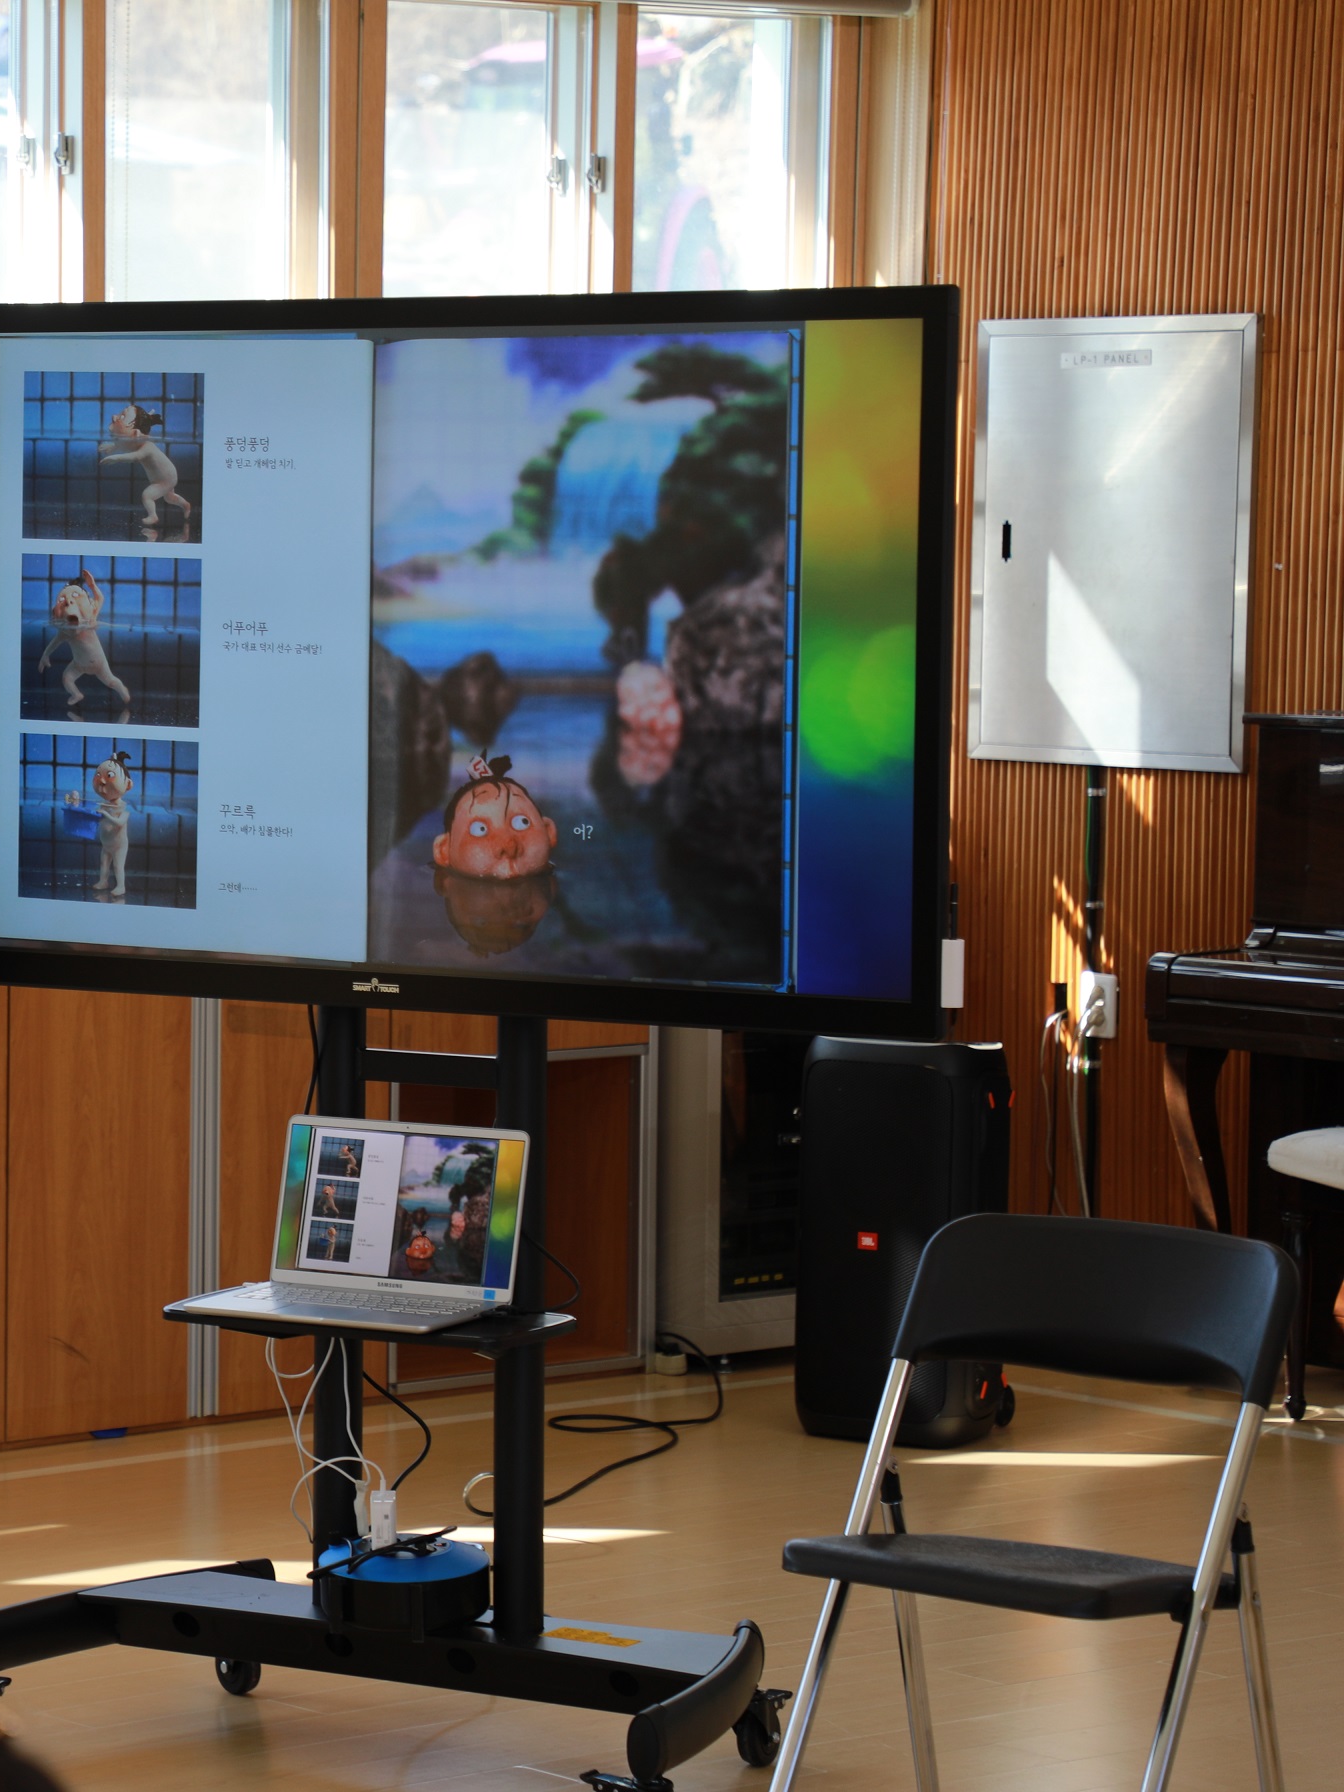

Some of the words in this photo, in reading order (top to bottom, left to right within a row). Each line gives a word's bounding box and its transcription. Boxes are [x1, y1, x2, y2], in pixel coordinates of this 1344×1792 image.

[1103, 353, 1139, 364] PANEL
[224, 437, 270, 452] 풍덩풍덩
[222, 620, 268, 636] 어푸어푸
[222, 641, 239, 652] 국가
[241, 642, 257, 652] 대표
[276, 643, 292, 654] 선수
[294, 644, 322, 655] 금메달!
[220, 804, 256, 819] 꾸르륵
[240, 825, 256, 835] 배가
[258, 826, 293, 837] 침몰한다!
[573, 823, 594, 841] 어?
[352, 984, 372, 992] SMART
[380, 986, 400, 994] TOUCH
[377, 1281, 403, 1289] SAMSUNG
